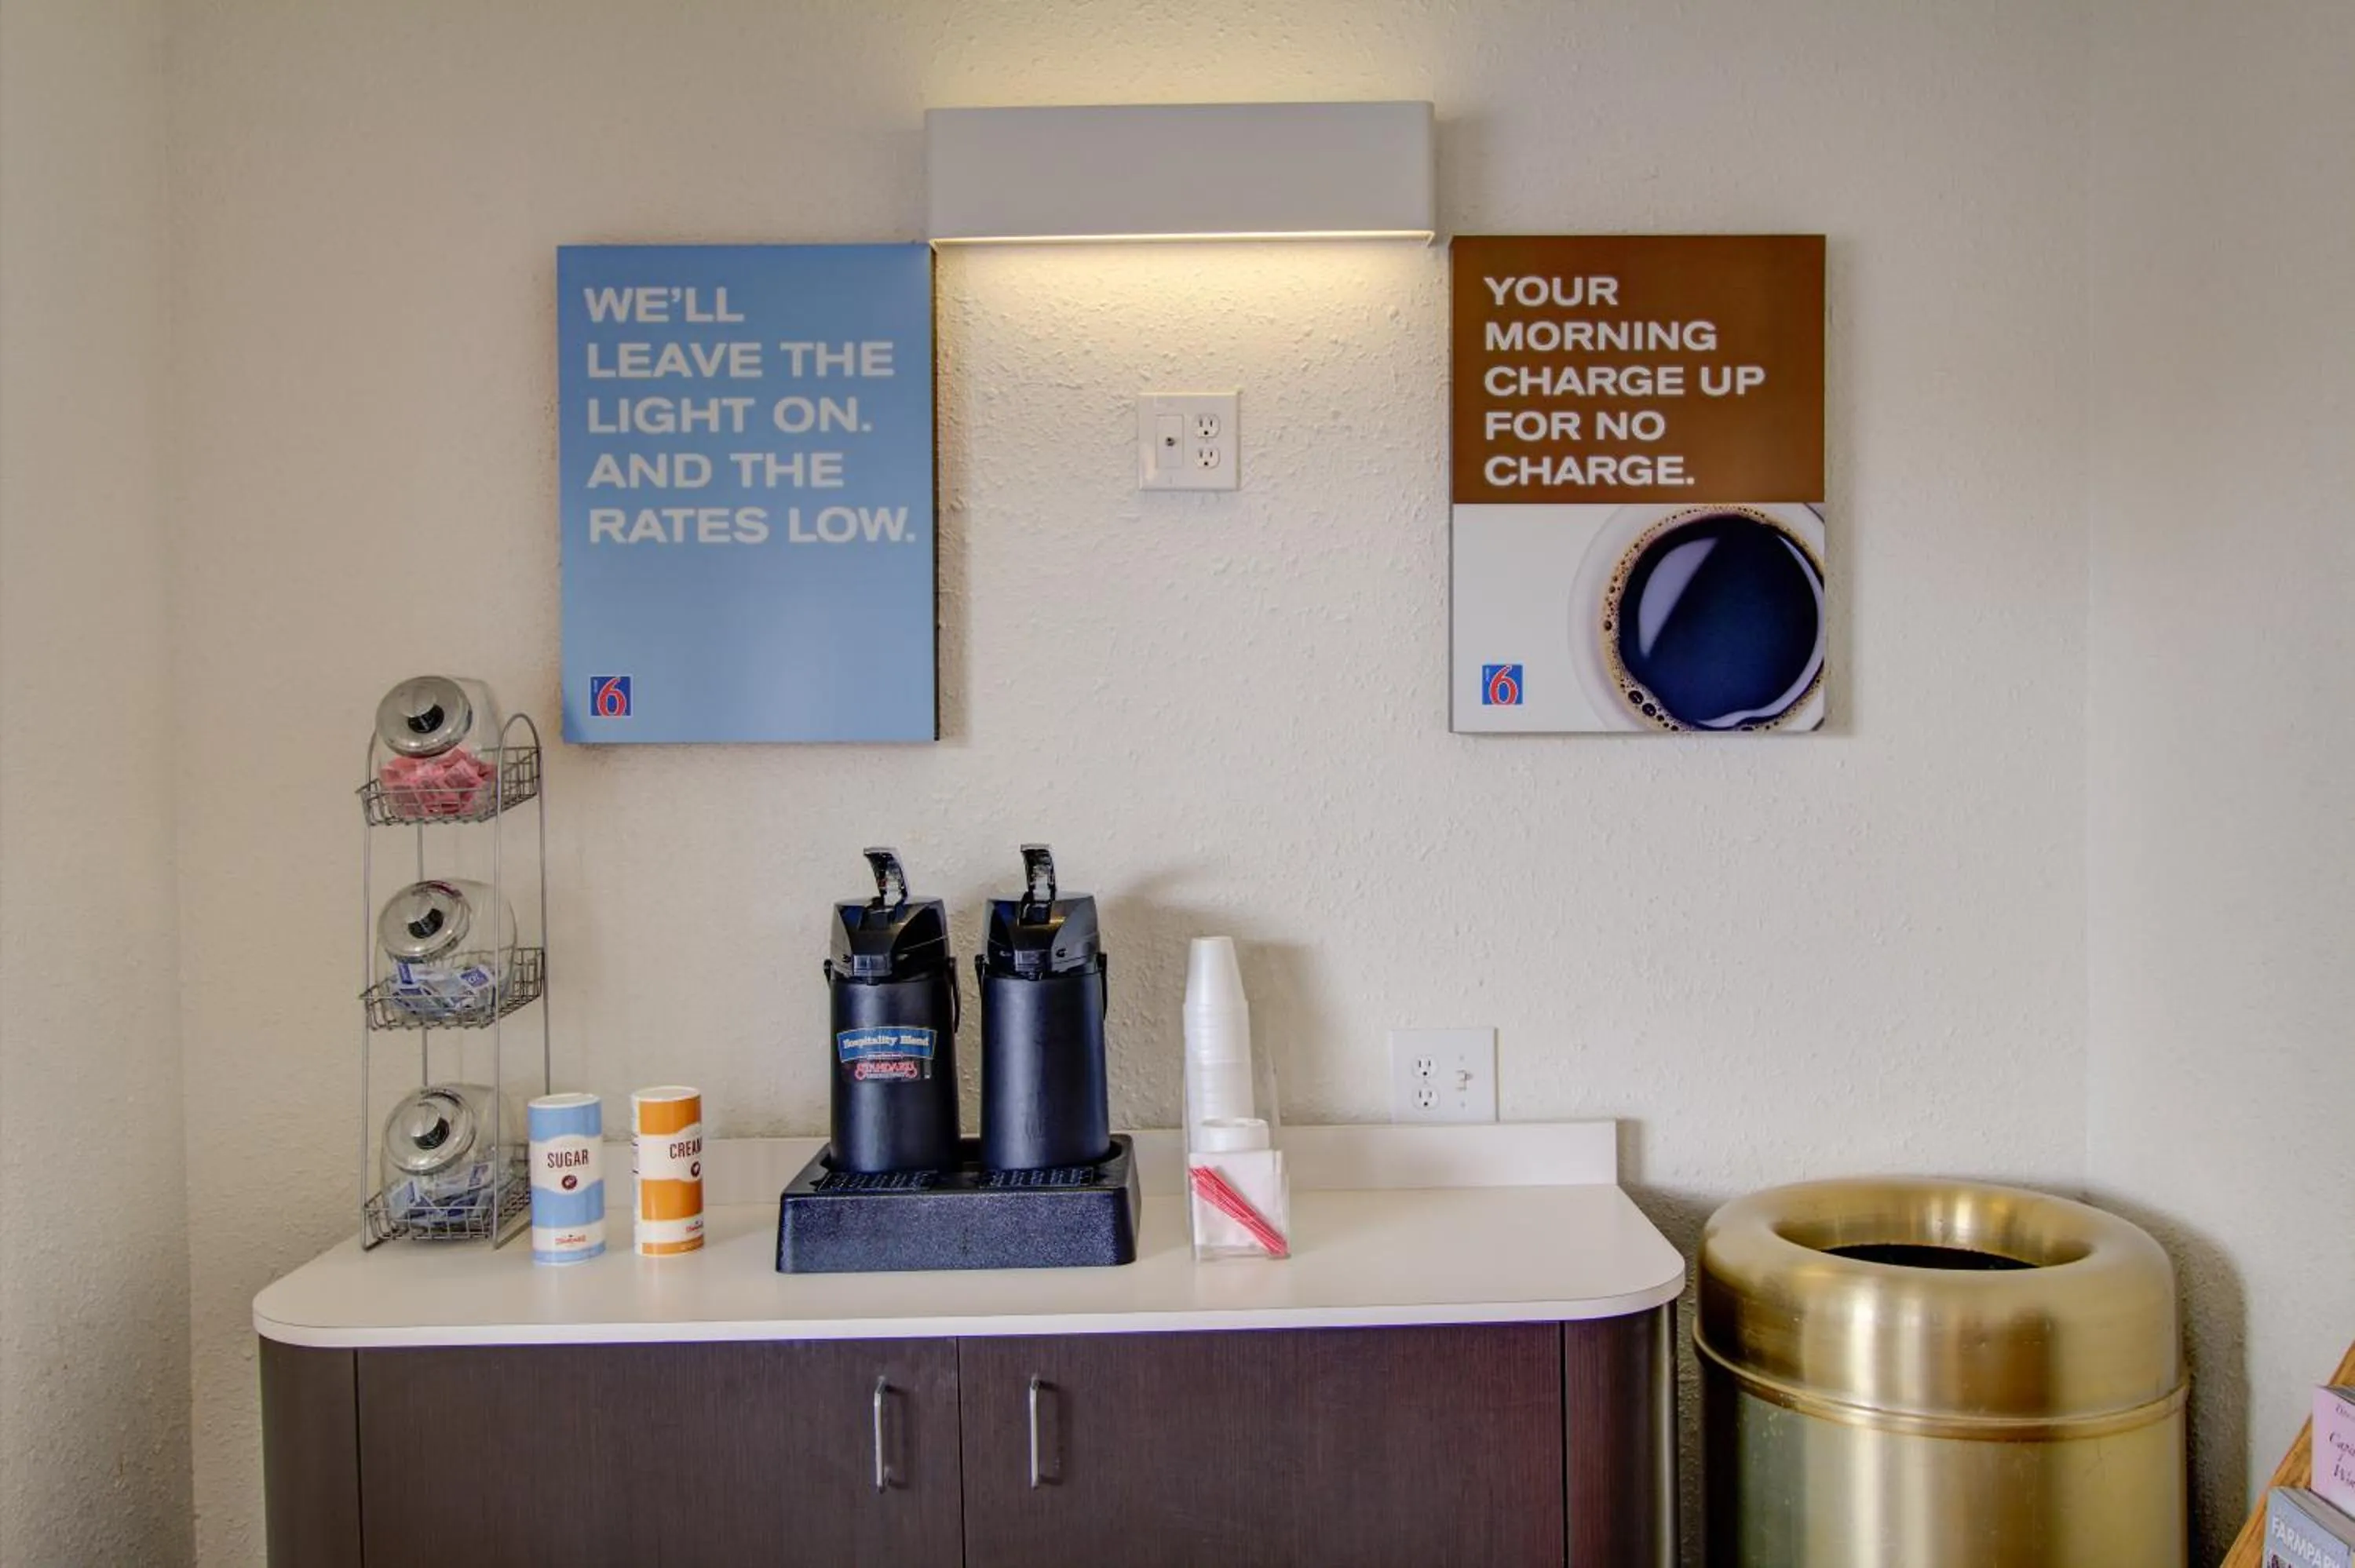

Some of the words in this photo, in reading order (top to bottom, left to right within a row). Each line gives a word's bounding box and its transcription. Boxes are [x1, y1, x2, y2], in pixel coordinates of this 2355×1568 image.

[1484, 276, 1618, 306] YOUR
[1484, 321, 1718, 351] MORNING
[587, 342, 762, 377] LEAVE
[780, 341, 894, 377] THE
[1484, 366, 1685, 396] CHARGE
[1699, 366, 1765, 396] UP
[587, 398, 754, 434] LIGHT
[772, 396, 871, 433] ON.
[1484, 410, 1582, 440] FOR
[1596, 410, 1666, 441] NO
[586, 453, 712, 488] AND
[729, 452, 843, 487] THE
[1484, 455, 1695, 486] CHARGE.
[589, 507, 769, 543] RATES
[788, 506, 916, 542] LOW.
[596, 676, 627, 717] 6
[1488, 665, 1519, 706] 6
[547, 1148, 589, 1169] SUGAR
